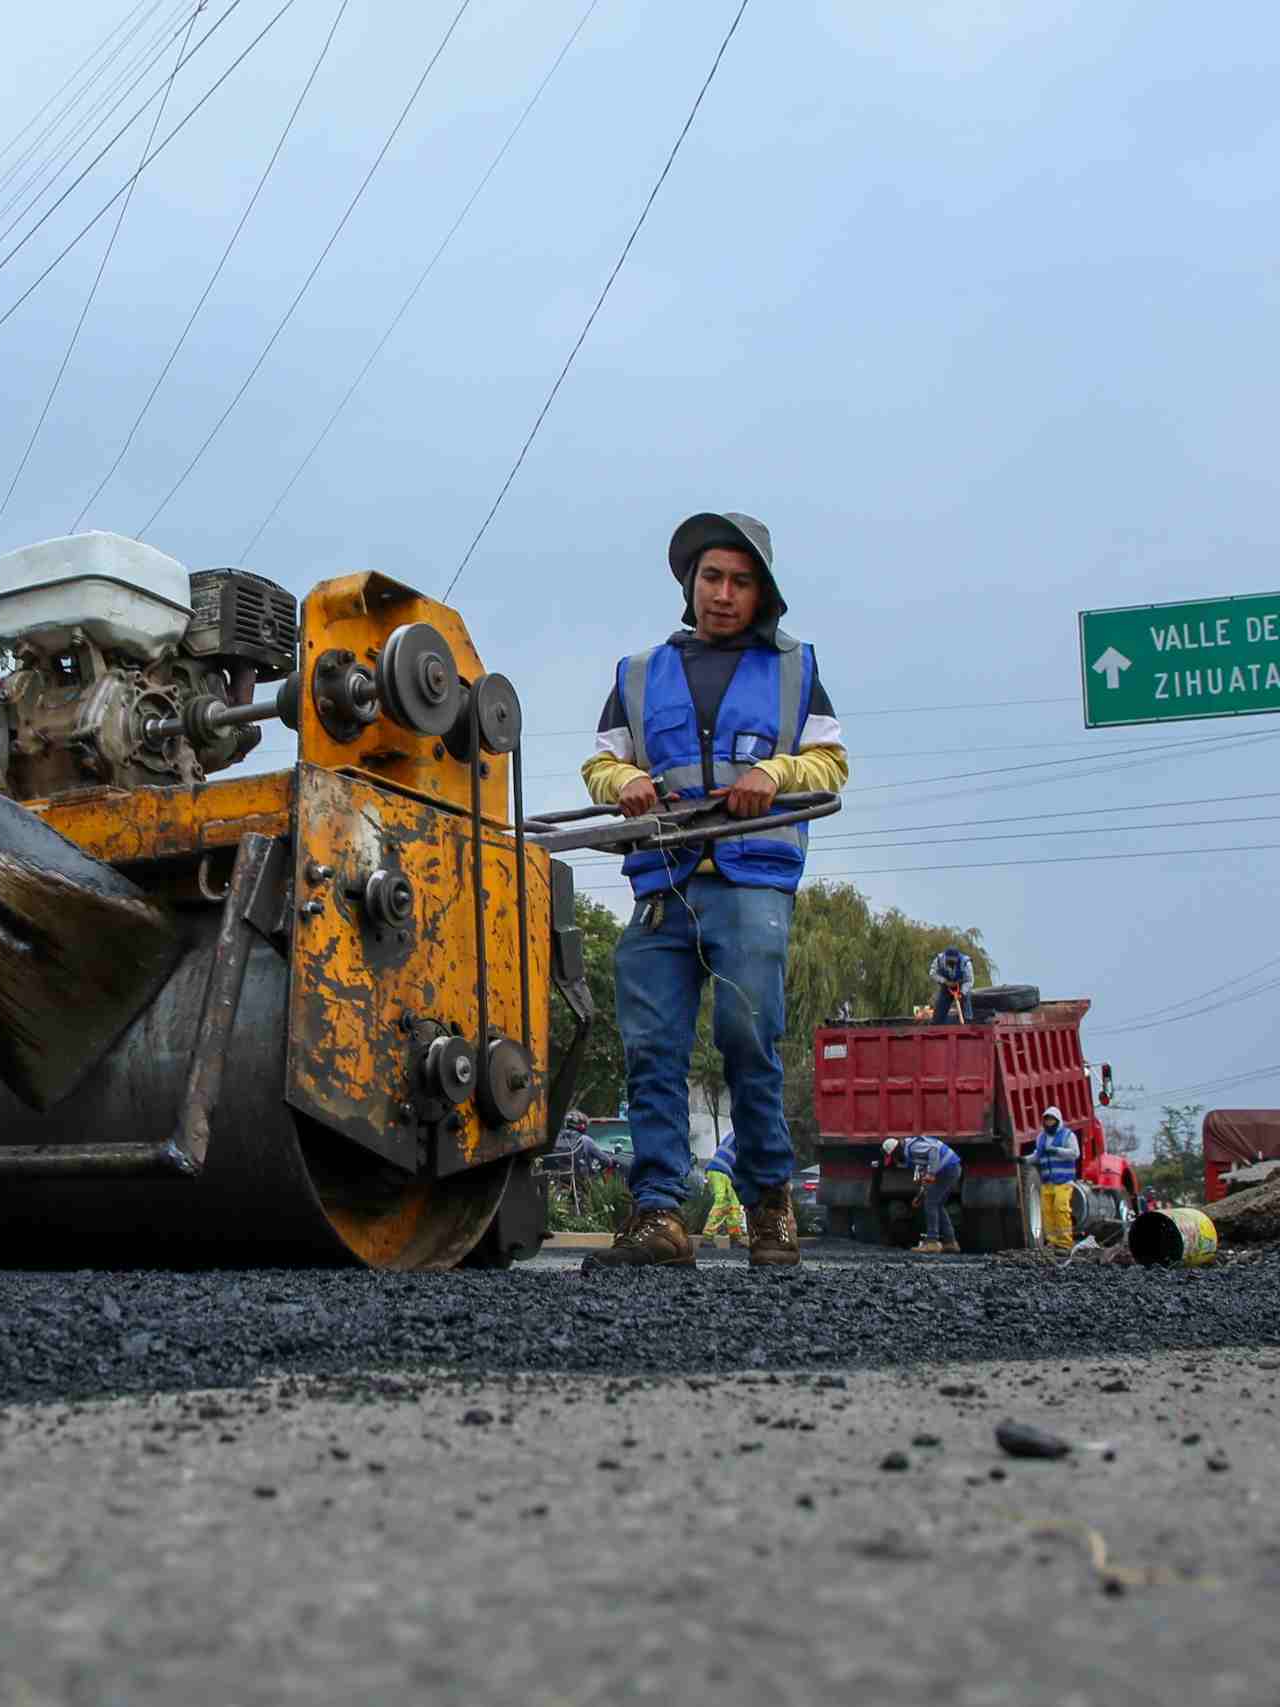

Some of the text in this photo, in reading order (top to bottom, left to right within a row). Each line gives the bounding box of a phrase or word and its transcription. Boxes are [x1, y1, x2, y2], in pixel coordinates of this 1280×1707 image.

[1150, 614, 1280, 652] VALLE DE
[1154, 662, 1280, 699] ZIHUATA
